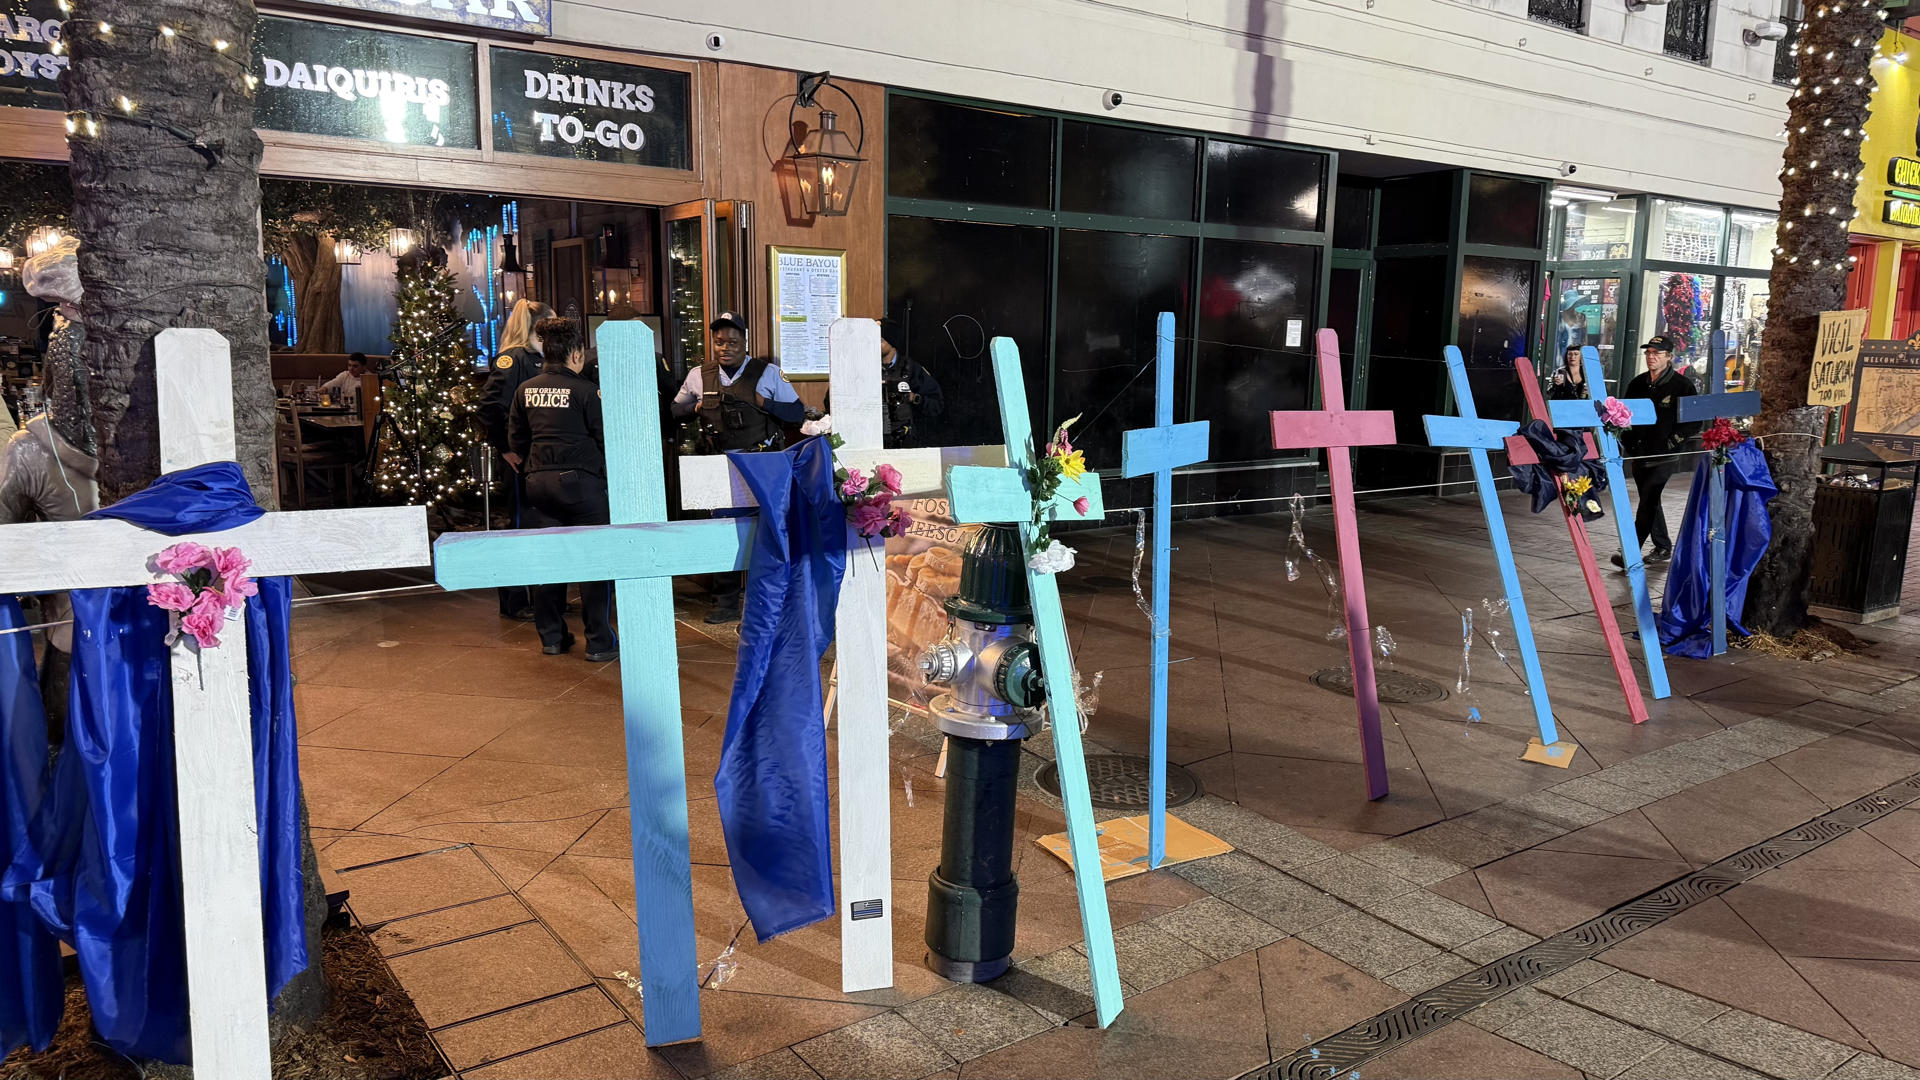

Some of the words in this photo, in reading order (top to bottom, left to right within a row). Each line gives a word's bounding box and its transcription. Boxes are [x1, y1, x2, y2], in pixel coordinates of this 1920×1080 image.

[262, 57, 450, 106] DAIQUIRIS
[524, 69, 655, 113] DRINKS
[533, 111, 645, 151] TO-GO
[806, 258, 838, 268] BAYOU
[524, 394, 569, 408] POLICE
[913, 498, 948, 515] FOS
